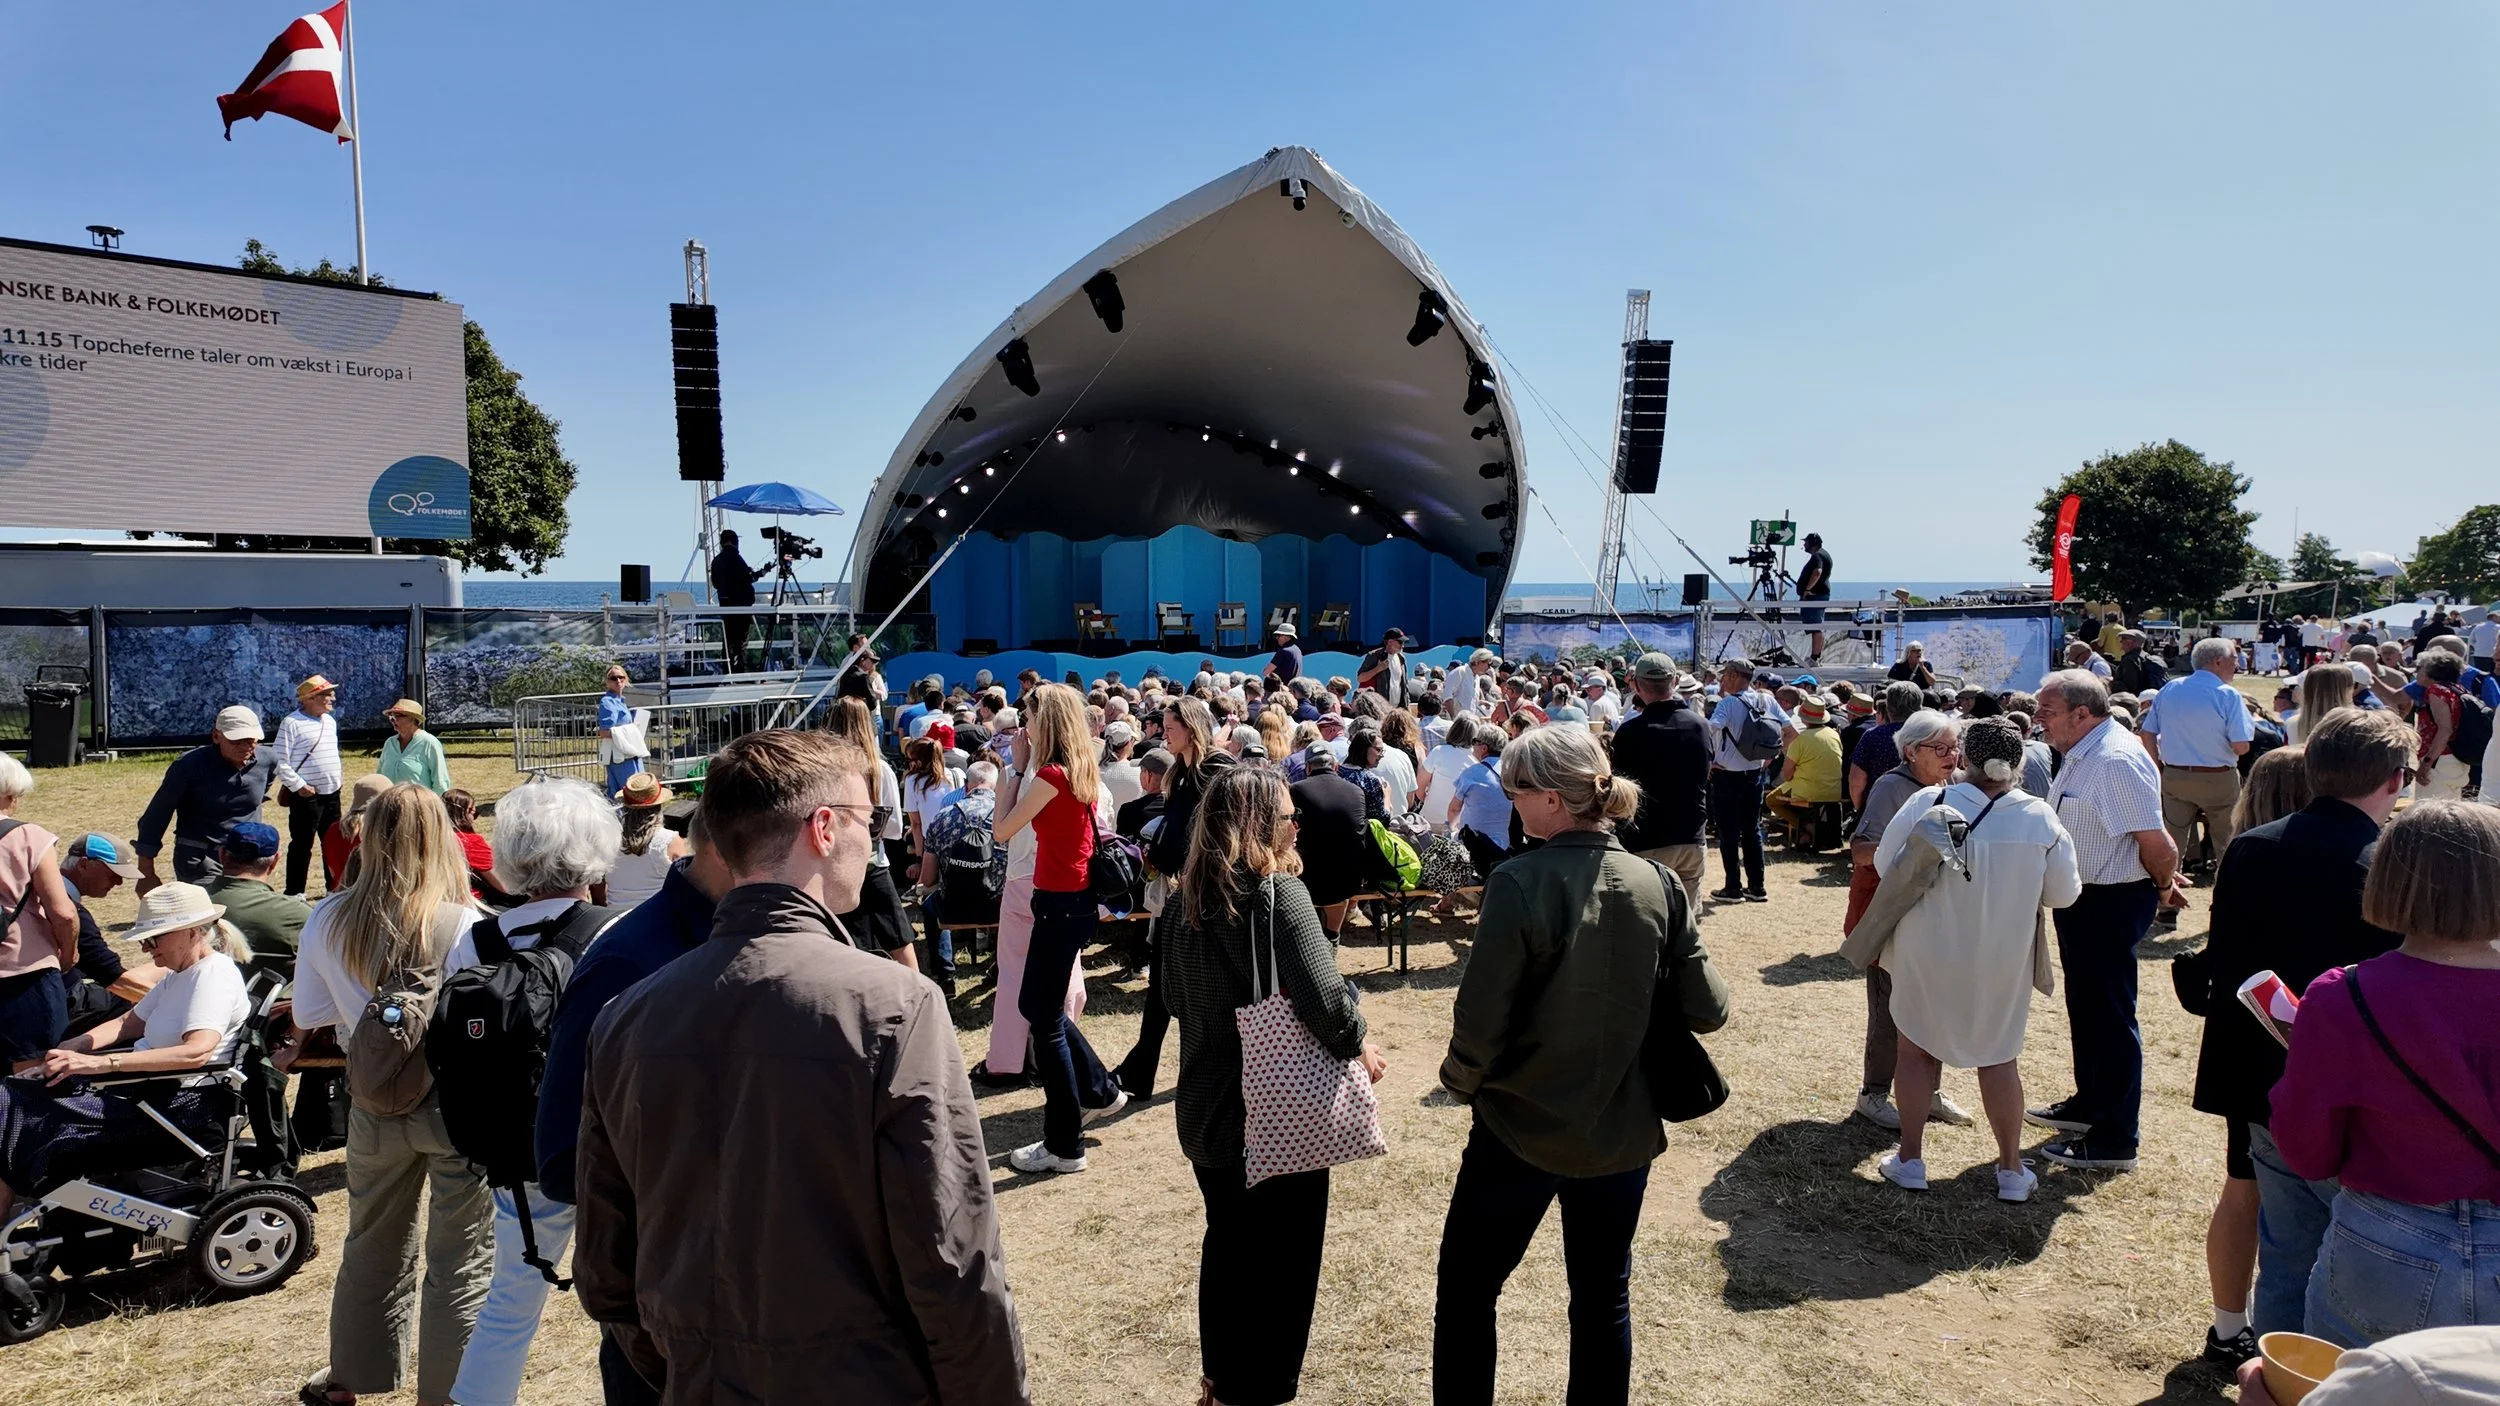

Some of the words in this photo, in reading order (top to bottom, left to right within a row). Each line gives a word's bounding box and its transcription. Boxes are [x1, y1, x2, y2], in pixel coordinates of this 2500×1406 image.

[0, 281, 56, 301] NSKE
[62, 287, 122, 309] BANK
[127, 295, 141, 311] &
[147, 297, 280, 325] FOLKEMØDET
[0, 349, 32, 367] kre
[39, 353, 87, 372] tider
[3, 328, 62, 348] 11.15
[68, 334, 195, 360] Topcheferne
[201, 348, 241, 365] taler
[247, 355, 275, 368] om
[280, 357, 331, 373] vækst
[336, 360, 340, 374] i
[346, 361, 403, 381] Europa
[408, 367, 412, 381] i
[417, 507, 468, 516] FOLKEMØDET
